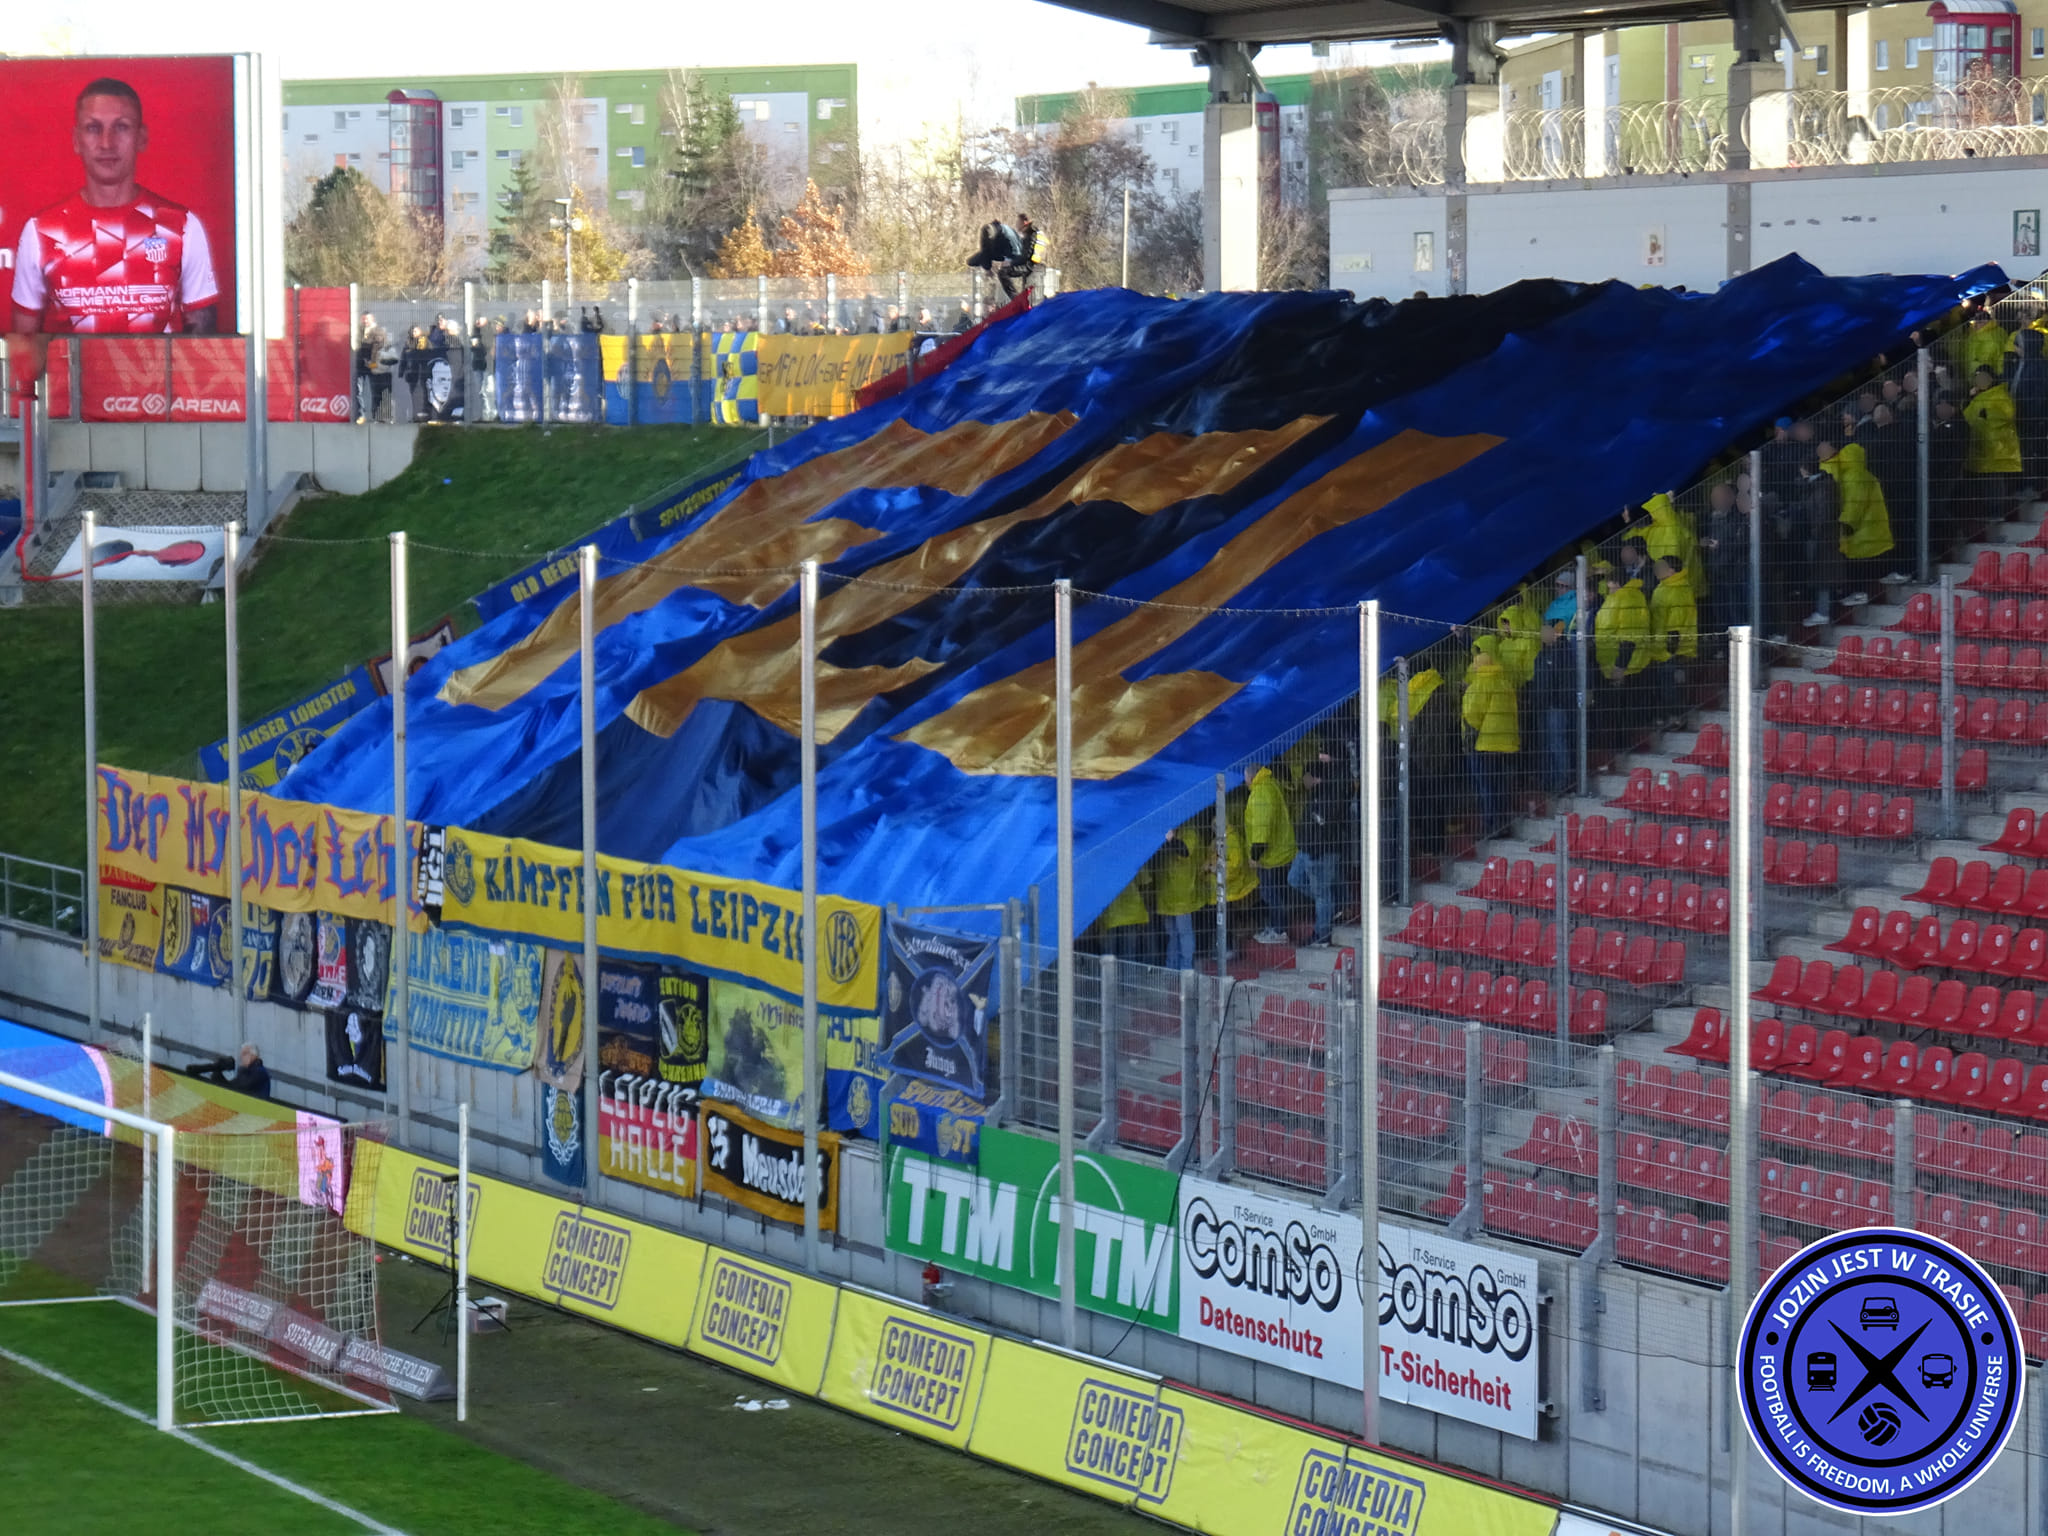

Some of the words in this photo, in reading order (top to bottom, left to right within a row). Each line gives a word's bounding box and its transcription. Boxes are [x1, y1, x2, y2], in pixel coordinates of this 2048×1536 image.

[55, 286, 128, 296] HOFMANN
[79, 295, 138, 305] METALL
[103, 397, 138, 413] GGZ
[170, 397, 240, 414] ARENA
[300, 397, 327, 413] GGZ
[289, 679, 357, 727] LOKISTEN
[110, 888, 147, 911] FANCLUB
[925, 1046, 957, 1077] Jungs
[599, 1069, 697, 1135] LEIPZIG
[610, 1119, 687, 1186] HALLE
[902, 1157, 1018, 1271] TTM
[1233, 1206, 1274, 1228] IT-Service
[1310, 1224, 1338, 1244] GmbH
[555, 1220, 625, 1268] COMEDIA
[1048, 1195, 1175, 1317] TTM
[1412, 1248, 1456, 1272] IT-Service
[1497, 1269, 1527, 1289] GmbH
[548, 1252, 618, 1301] CONCEPT
[715, 1267, 784, 1321] COMEDIA
[284, 1322, 338, 1361] SUPRAMAX
[707, 1302, 778, 1356] CONCEPT
[1200, 1296, 1323, 1359] Datenschutz
[402, 1360, 433, 1384] FOLIEN
[886, 1326, 966, 1383] COMEDIA
[1380, 1345, 1512, 1411] T-Sicherheit
[877, 1364, 960, 1420] CONCEPT
[1081, 1389, 1174, 1452] COMEDIA
[1073, 1429, 1167, 1492] CONCEPT
[1304, 1461, 1413, 1529] COMEDIA
